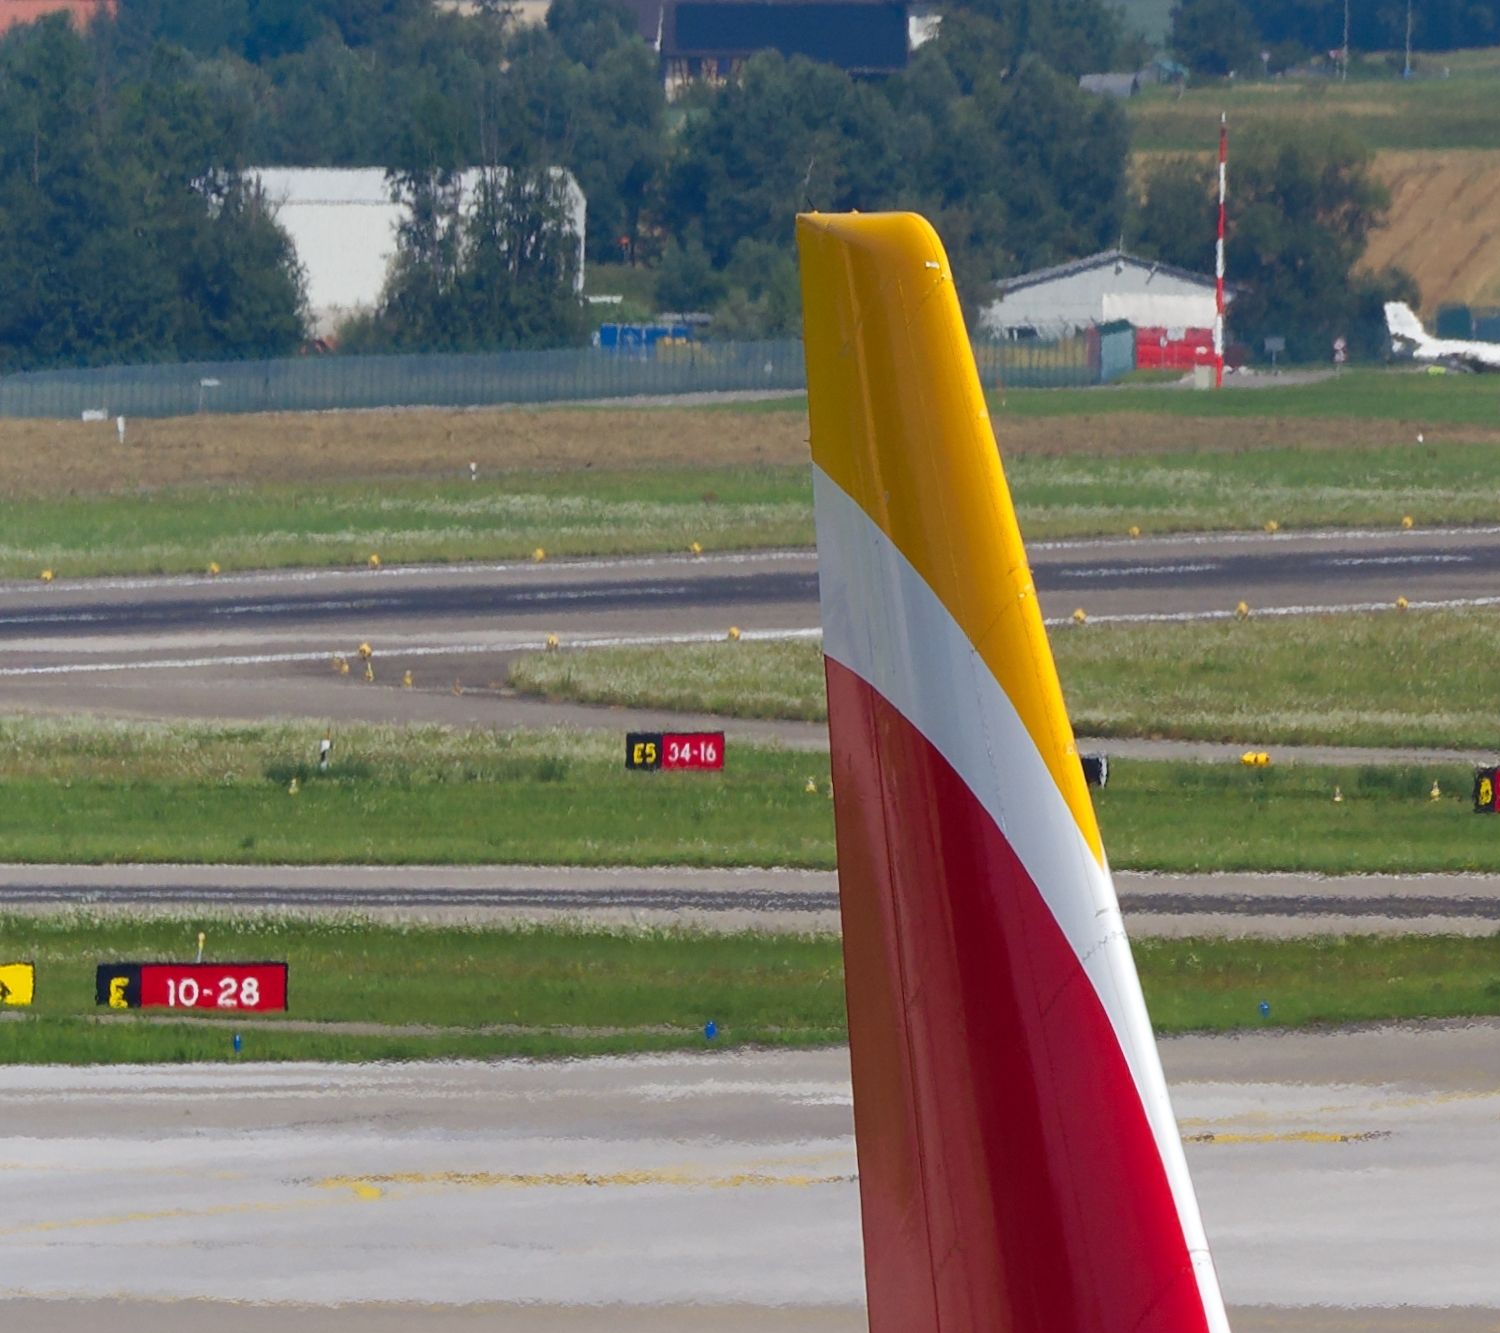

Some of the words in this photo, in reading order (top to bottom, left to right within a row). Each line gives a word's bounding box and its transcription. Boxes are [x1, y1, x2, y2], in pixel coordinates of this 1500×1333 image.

[633, 742, 657, 764] E5
[668, 741, 716, 763] 34-16
[109, 976, 129, 1009] E
[167, 977, 259, 1008] 10-28
